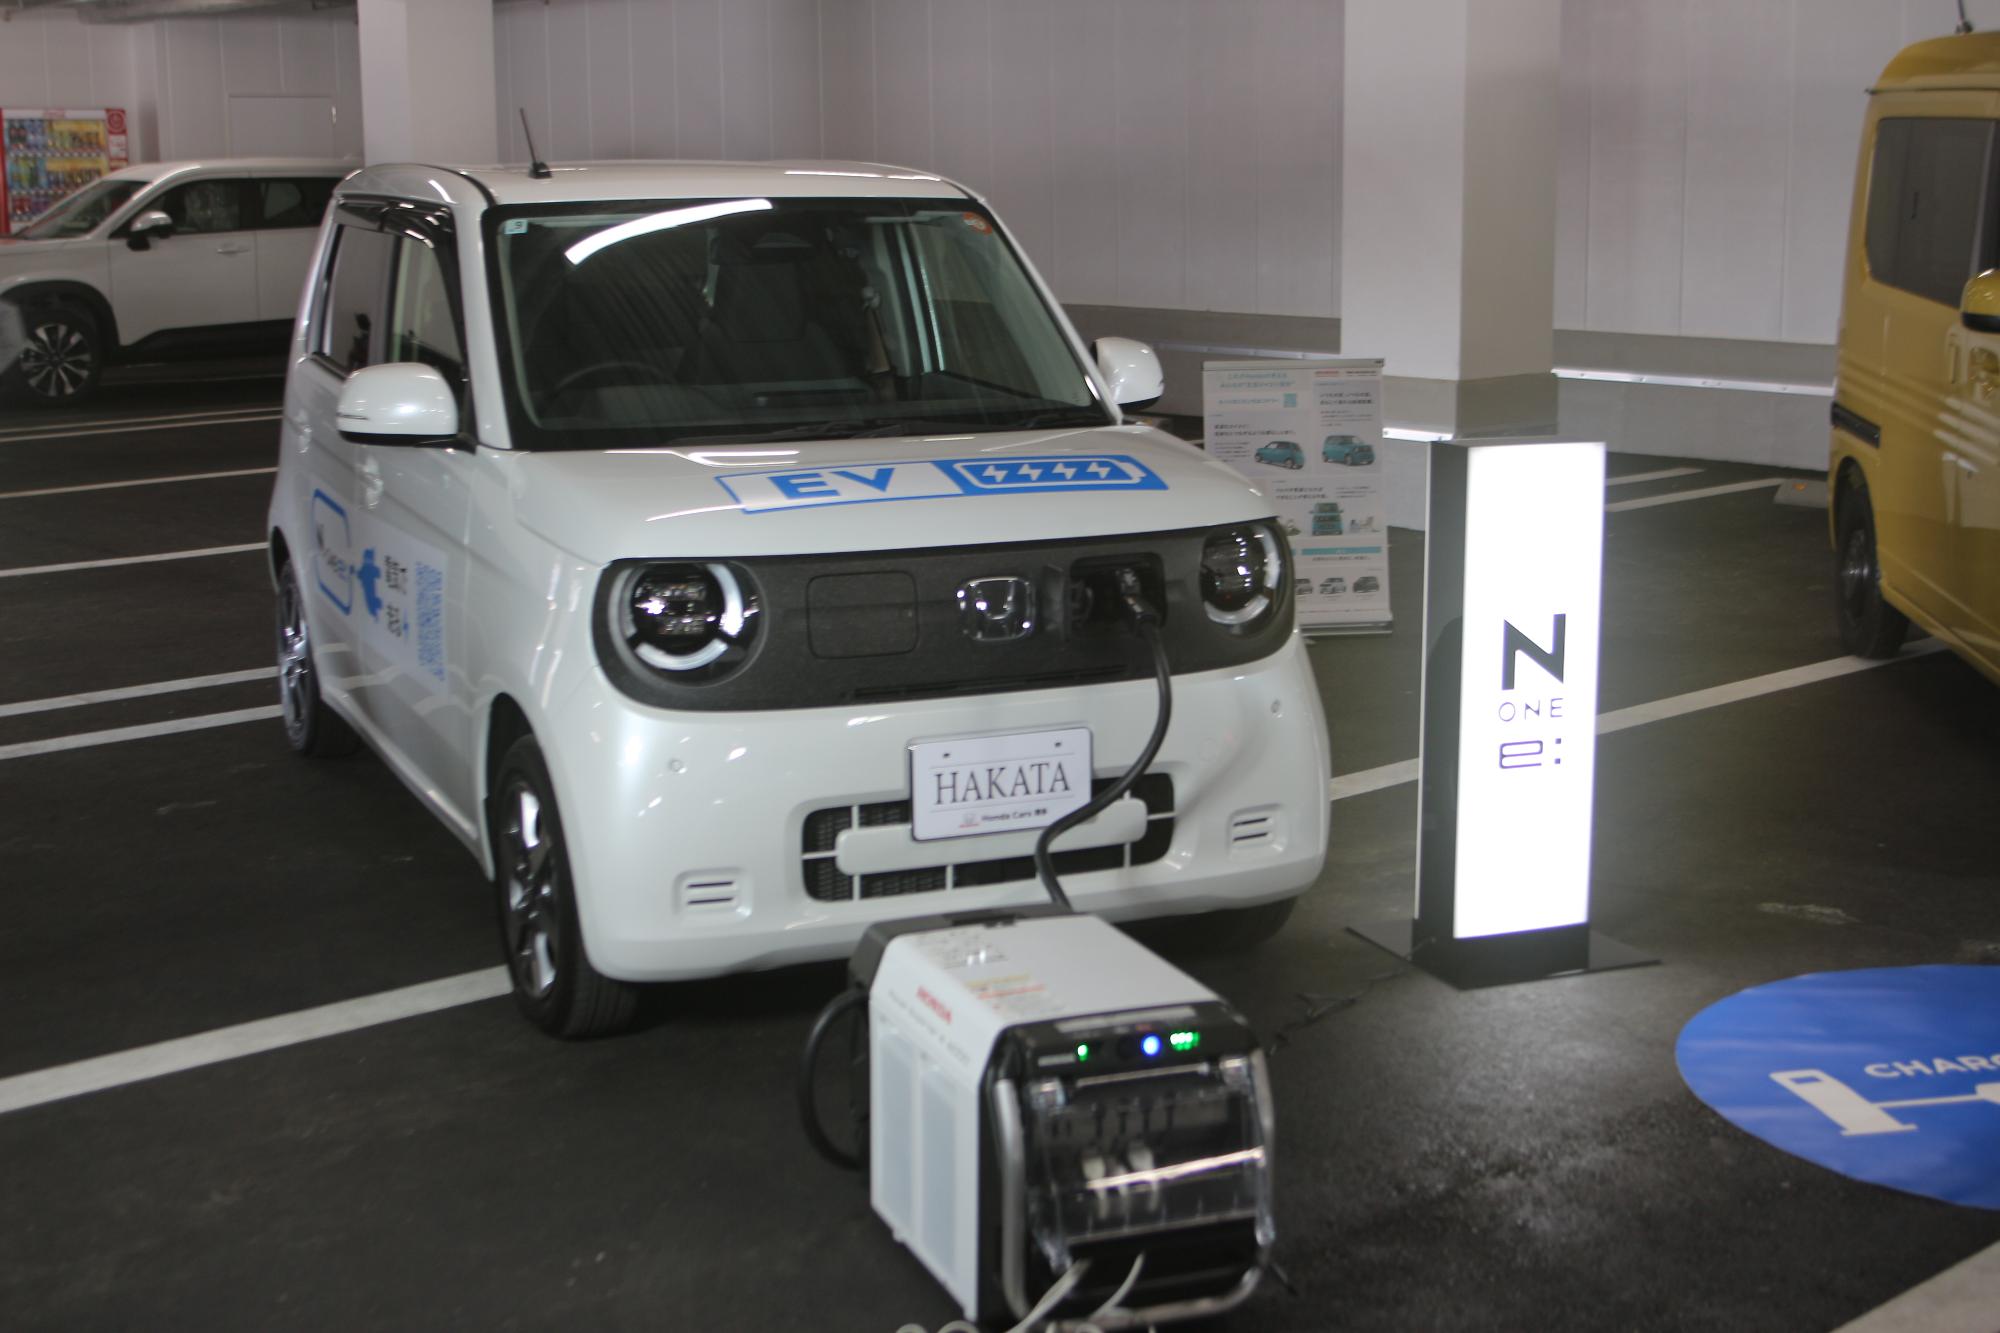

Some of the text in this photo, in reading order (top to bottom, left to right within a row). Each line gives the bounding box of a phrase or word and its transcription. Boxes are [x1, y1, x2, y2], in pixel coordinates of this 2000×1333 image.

[768, 467, 895, 500] EV
[1501, 613, 1567, 691] N
[1498, 697, 1564, 722] ONE
[934, 761, 1071, 805] HAKATA
